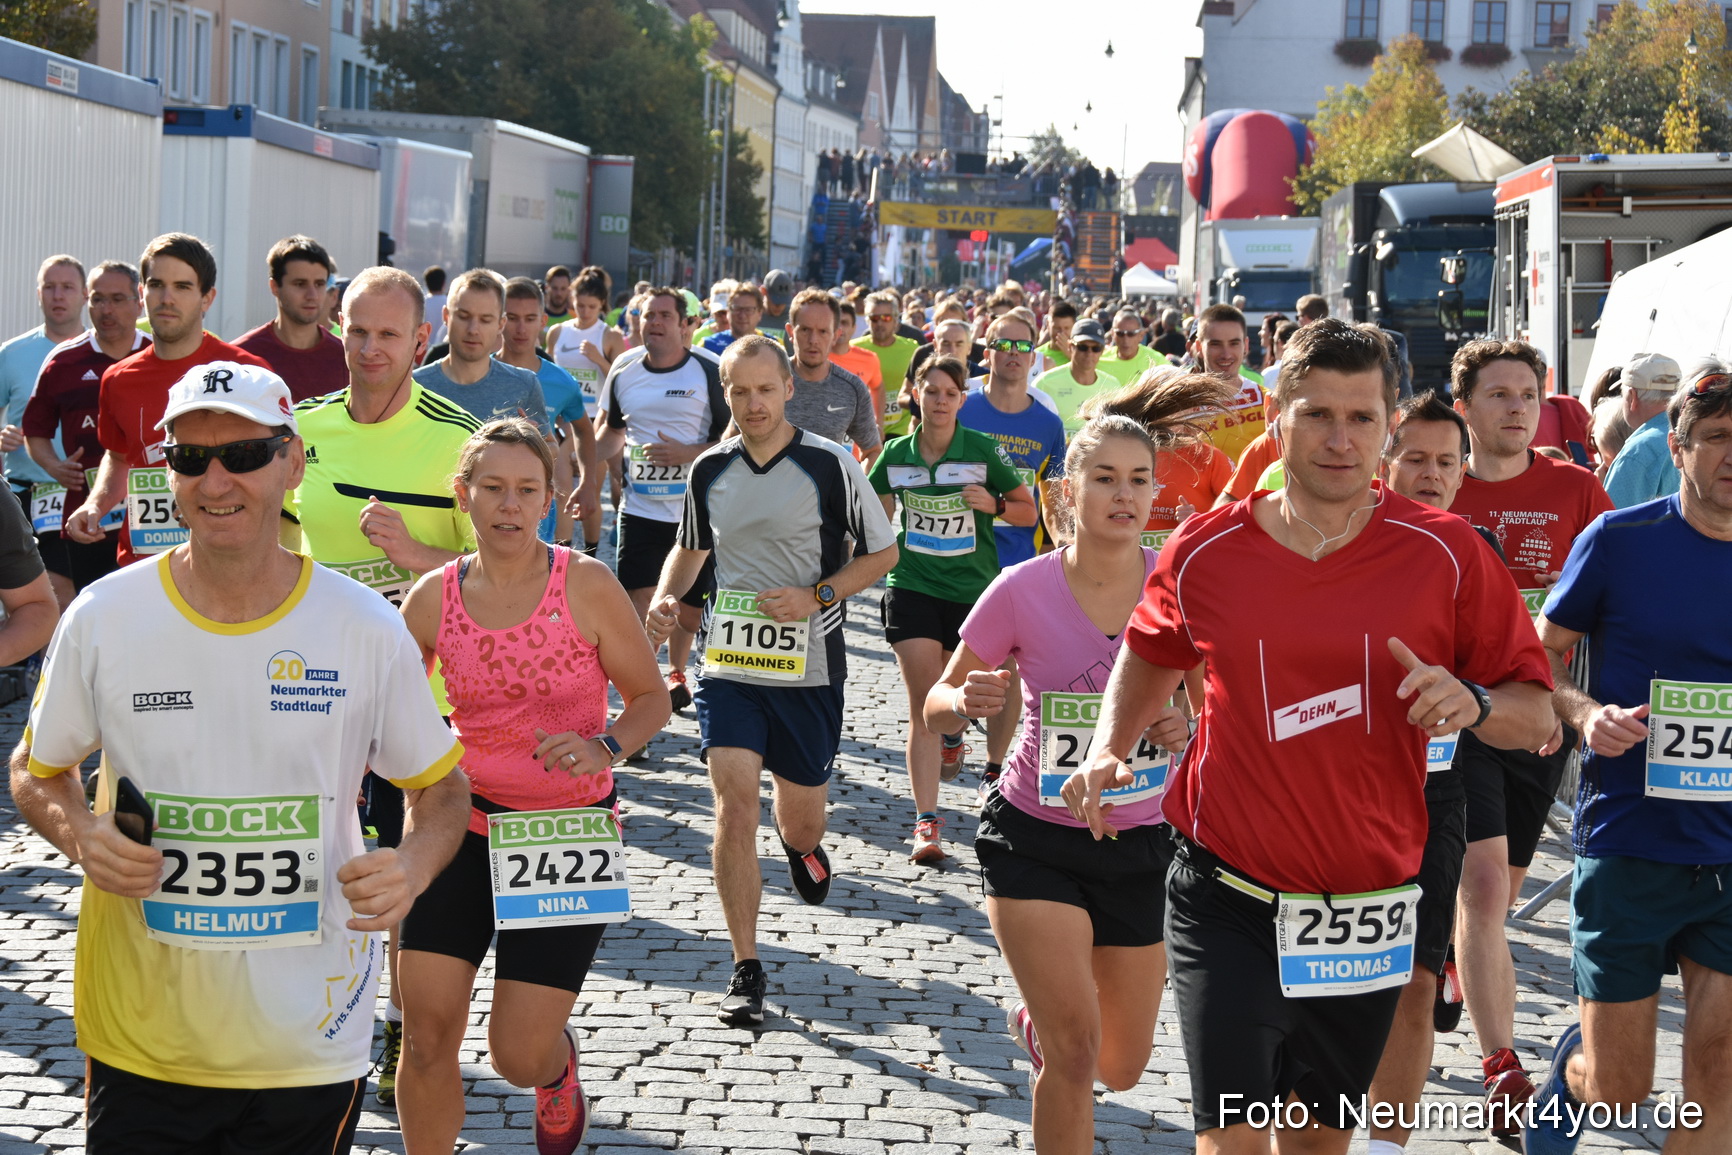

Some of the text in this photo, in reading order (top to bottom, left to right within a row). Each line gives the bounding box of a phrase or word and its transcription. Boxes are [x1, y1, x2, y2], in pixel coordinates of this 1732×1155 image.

[937, 209, 998, 226] START
[636, 465, 682, 480] 2222
[135, 474, 167, 489] BO
[648, 486, 669, 494] UWE
[38, 497, 62, 515] 24
[908, 495, 966, 512] BOCK
[913, 513, 965, 535] 2777
[1500, 518, 1547, 526] STADTLAUF
[1502, 511, 1558, 521] NEUMARKTER
[144, 532, 188, 544] DOMIN
[1519, 550, 1551, 558] 19.09.2010
[722, 595, 759, 615] BO
[722, 621, 796, 651] 1105
[271, 659, 303, 680] 20
[715, 653, 795, 670] JOHANNES
[308, 671, 335, 680] JAHRE
[133, 691, 193, 707] BOCK
[271, 685, 346, 697] Neumarkter
[271, 701, 332, 715] Stadtlauf
[1299, 700, 1337, 724] DEHN
[1056, 733, 1158, 767] 24
[1663, 723, 1732, 760] 254
[1680, 771, 1732, 787] KLAU
[156, 800, 306, 836] BOCK
[501, 814, 612, 843] BOCK
[307, 852, 315, 860] C
[161, 849, 301, 896] 2353
[507, 849, 612, 888] 2422
[538, 896, 589, 913] NINA
[174, 911, 287, 932] HELMUT
[1297, 901, 1406, 945] 2559
[1306, 955, 1392, 979] THOMAS
[325, 1012, 349, 1040] 14./15.
[346, 960, 372, 1012] September
